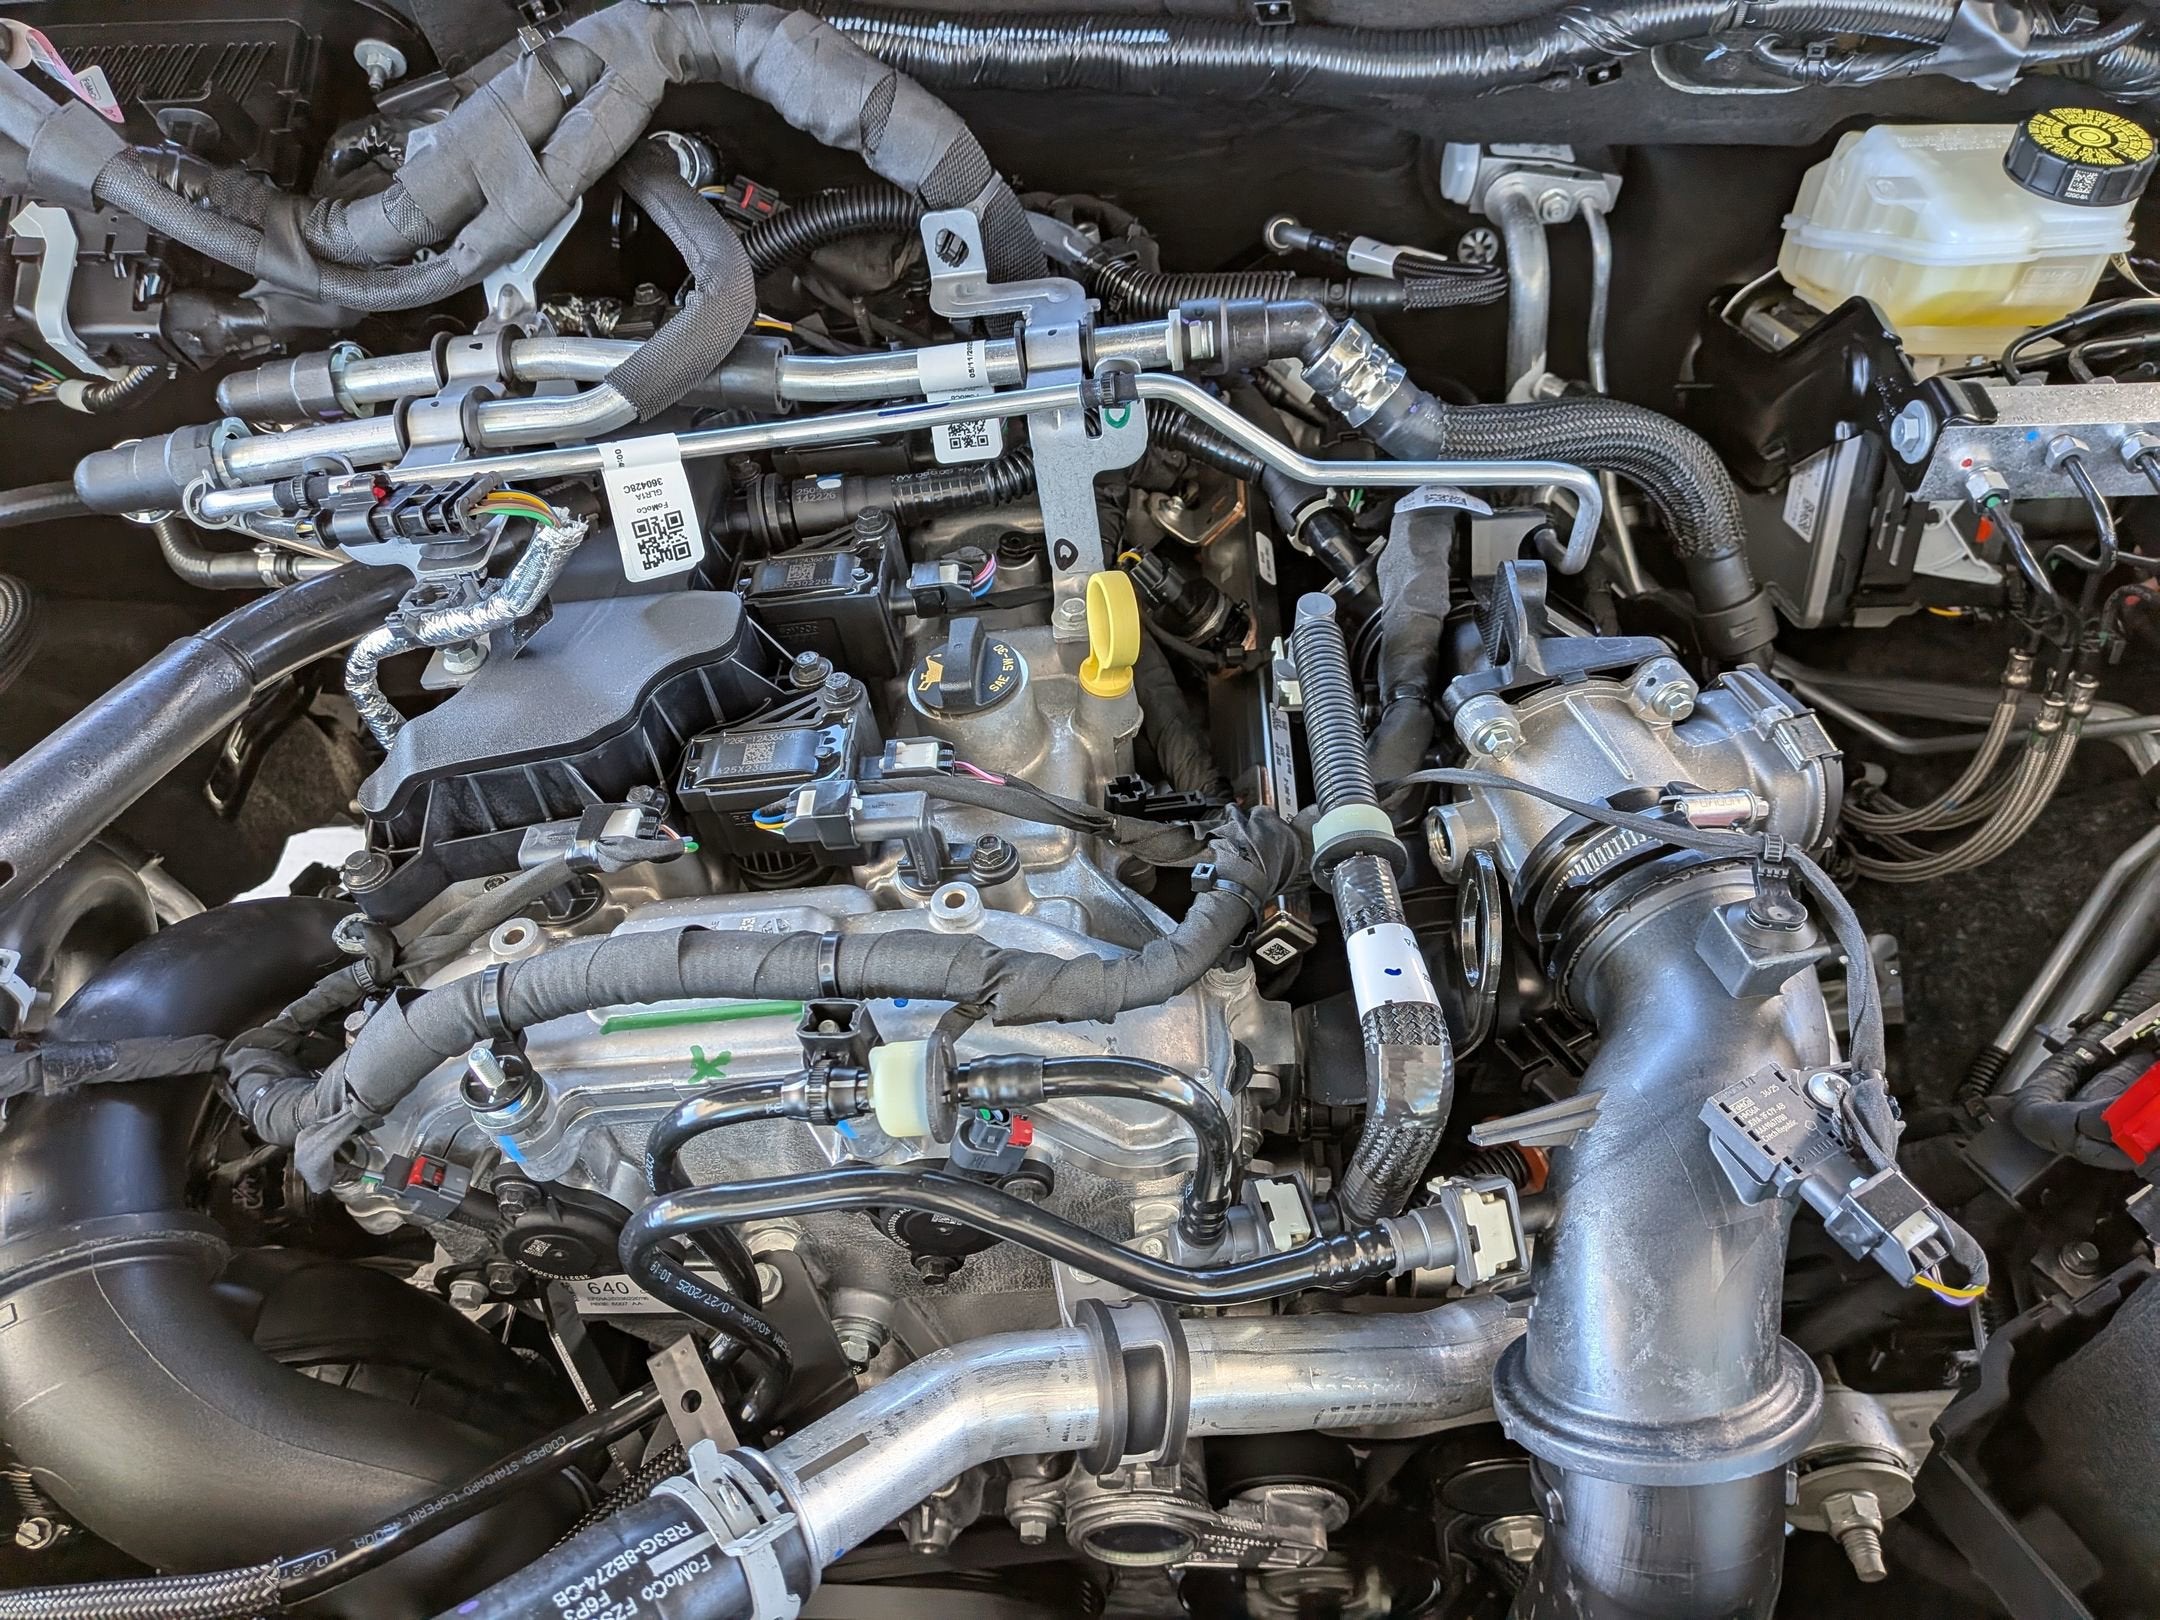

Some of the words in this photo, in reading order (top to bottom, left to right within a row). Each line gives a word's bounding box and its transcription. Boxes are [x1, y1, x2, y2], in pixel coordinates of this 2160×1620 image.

[623, 477, 664, 494] 360428C
[635, 488, 663, 500] GLR1A
[637, 501, 669, 514] FoMoCo
[993, 644, 1014, 671] 5W-30
[989, 674, 1010, 692] SAE
[1760, 1084, 1780, 1098] 36/25
[587, 1281, 630, 1295] 640
[524, 1435, 566, 1465] COOPER
[463, 1460, 520, 1495] STANDARD
[553, 1521, 693, 1608] RB3G-8B274-CB
[641, 1554, 712, 1601] FoMoCo
